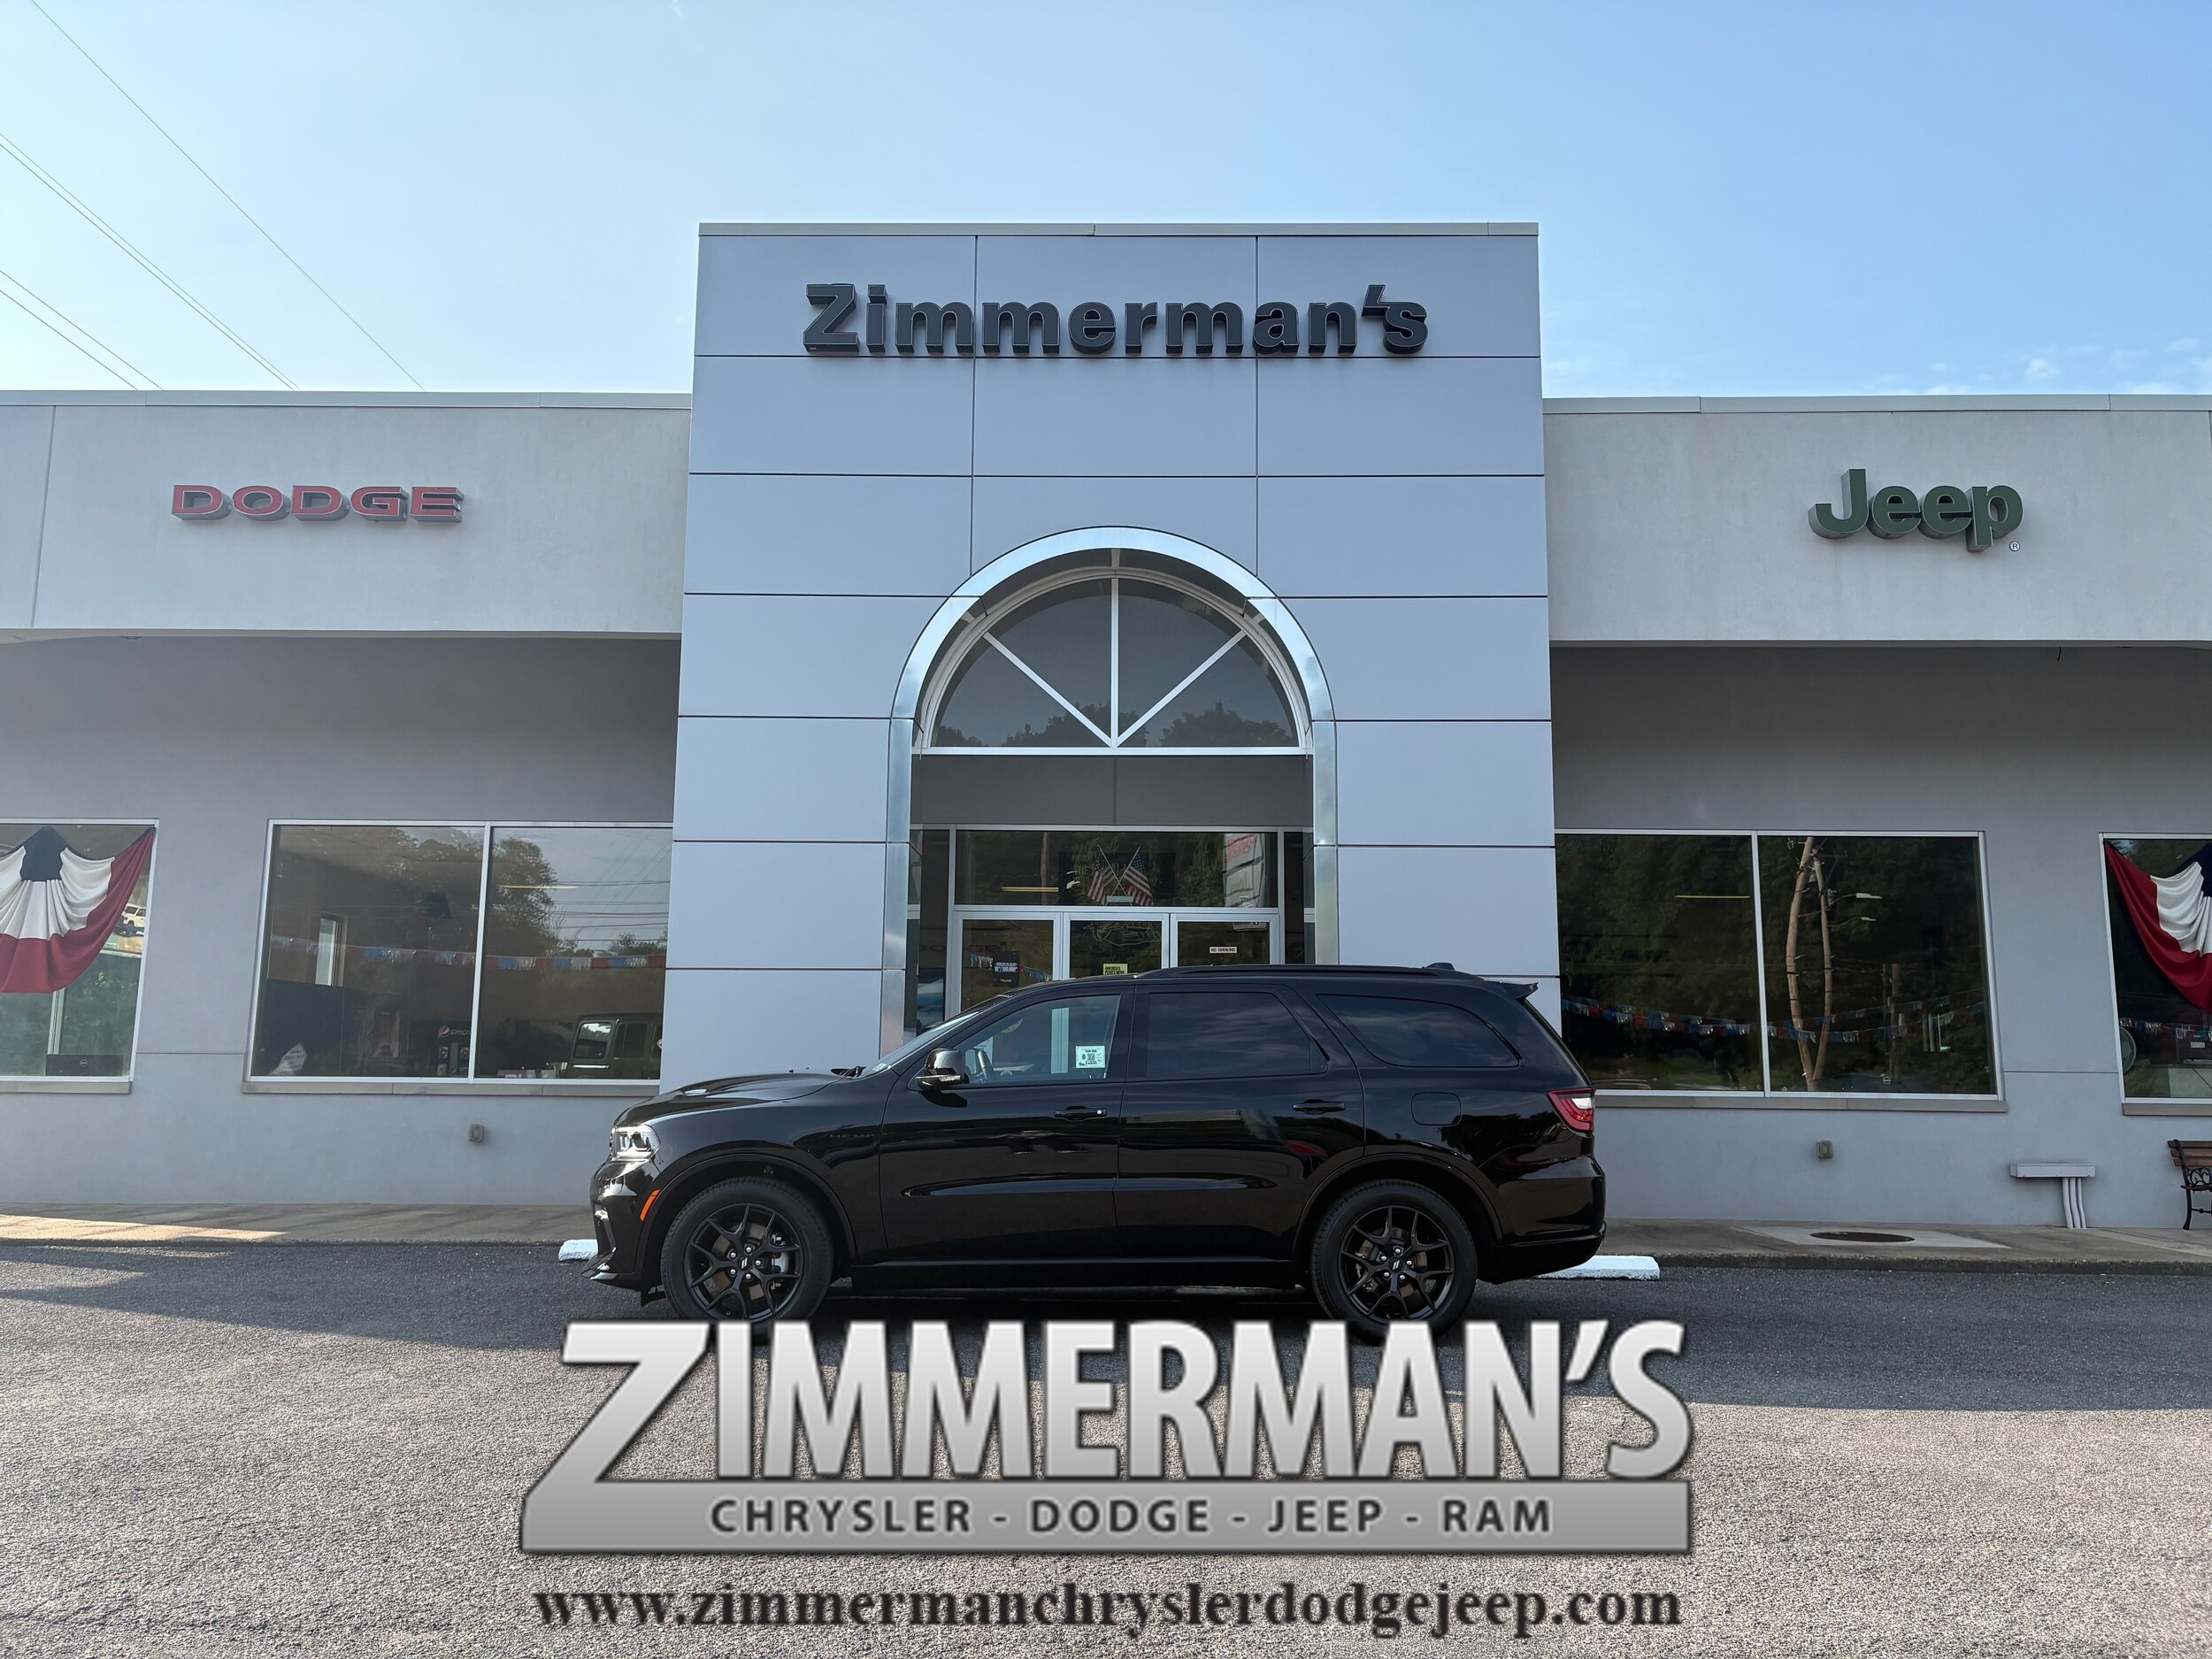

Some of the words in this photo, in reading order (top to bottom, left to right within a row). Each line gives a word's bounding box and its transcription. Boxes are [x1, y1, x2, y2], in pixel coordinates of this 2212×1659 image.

[803, 282, 1429, 354] Zimmerman's
[172, 484, 465, 523] DODGE
[1808, 468, 2024, 553] Jeep
